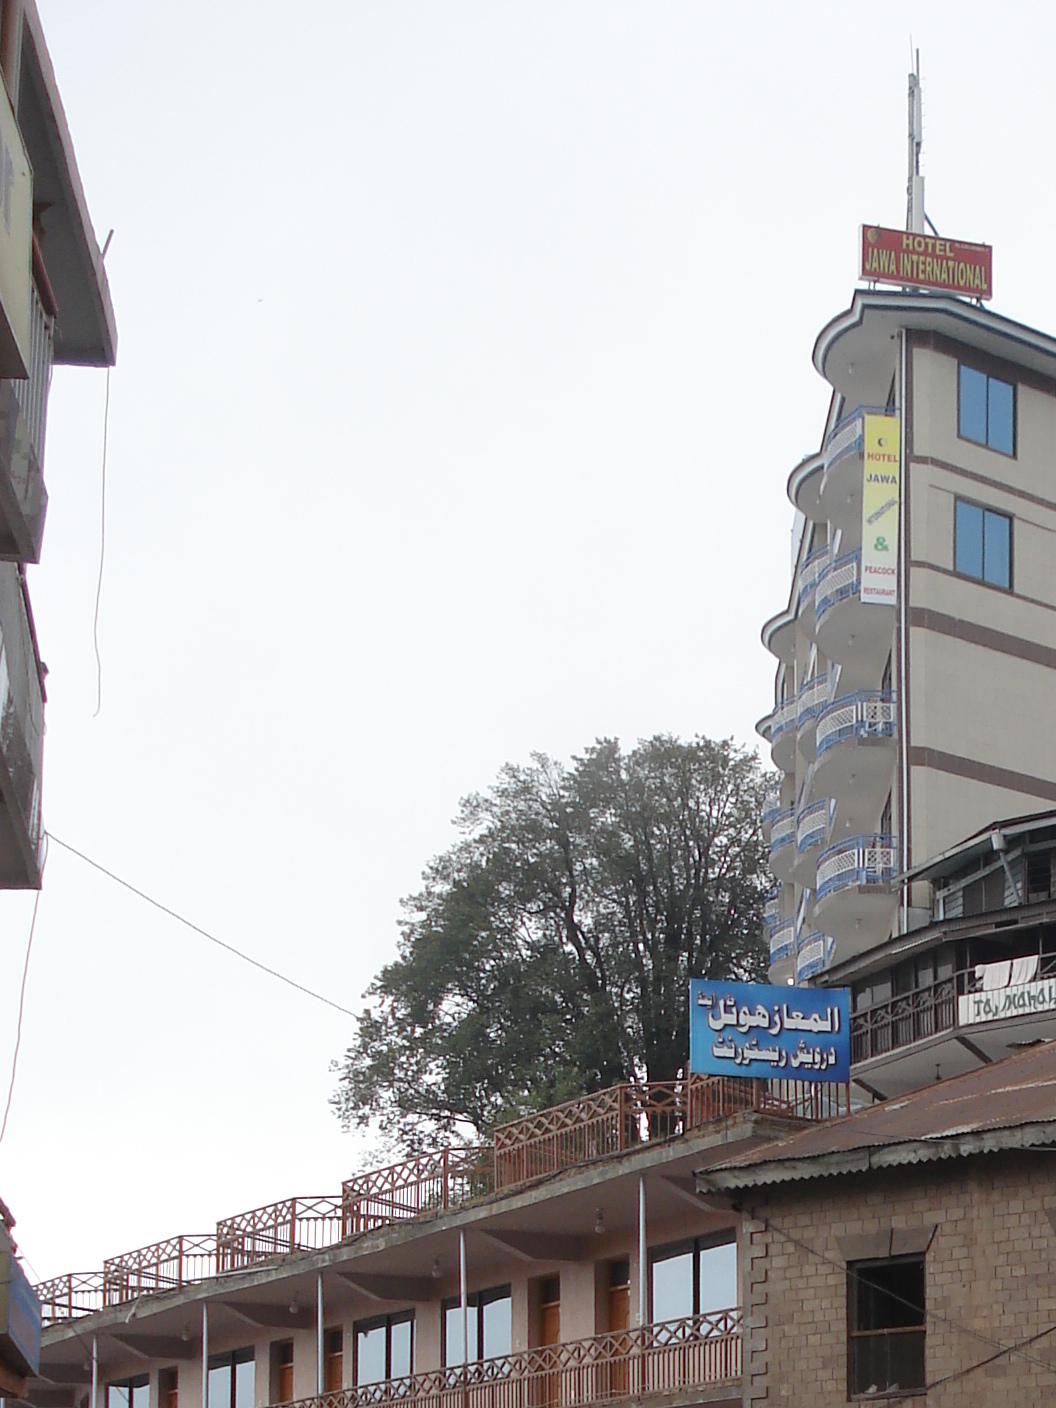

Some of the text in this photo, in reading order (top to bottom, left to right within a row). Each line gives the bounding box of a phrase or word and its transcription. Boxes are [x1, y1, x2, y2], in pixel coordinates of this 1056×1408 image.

[902, 235, 955, 257] HOTEL
[866, 248, 988, 290] JAWA INTERNATIONAL
[867, 453, 898, 463] HOTEL
[866, 474, 898, 485] JAWA
[874, 536, 889, 551] &
[865, 566, 896, 576] PEACOCK
[863, 587, 896, 597] RESTAURANT
[790, 1039, 836, 1070] درویش
